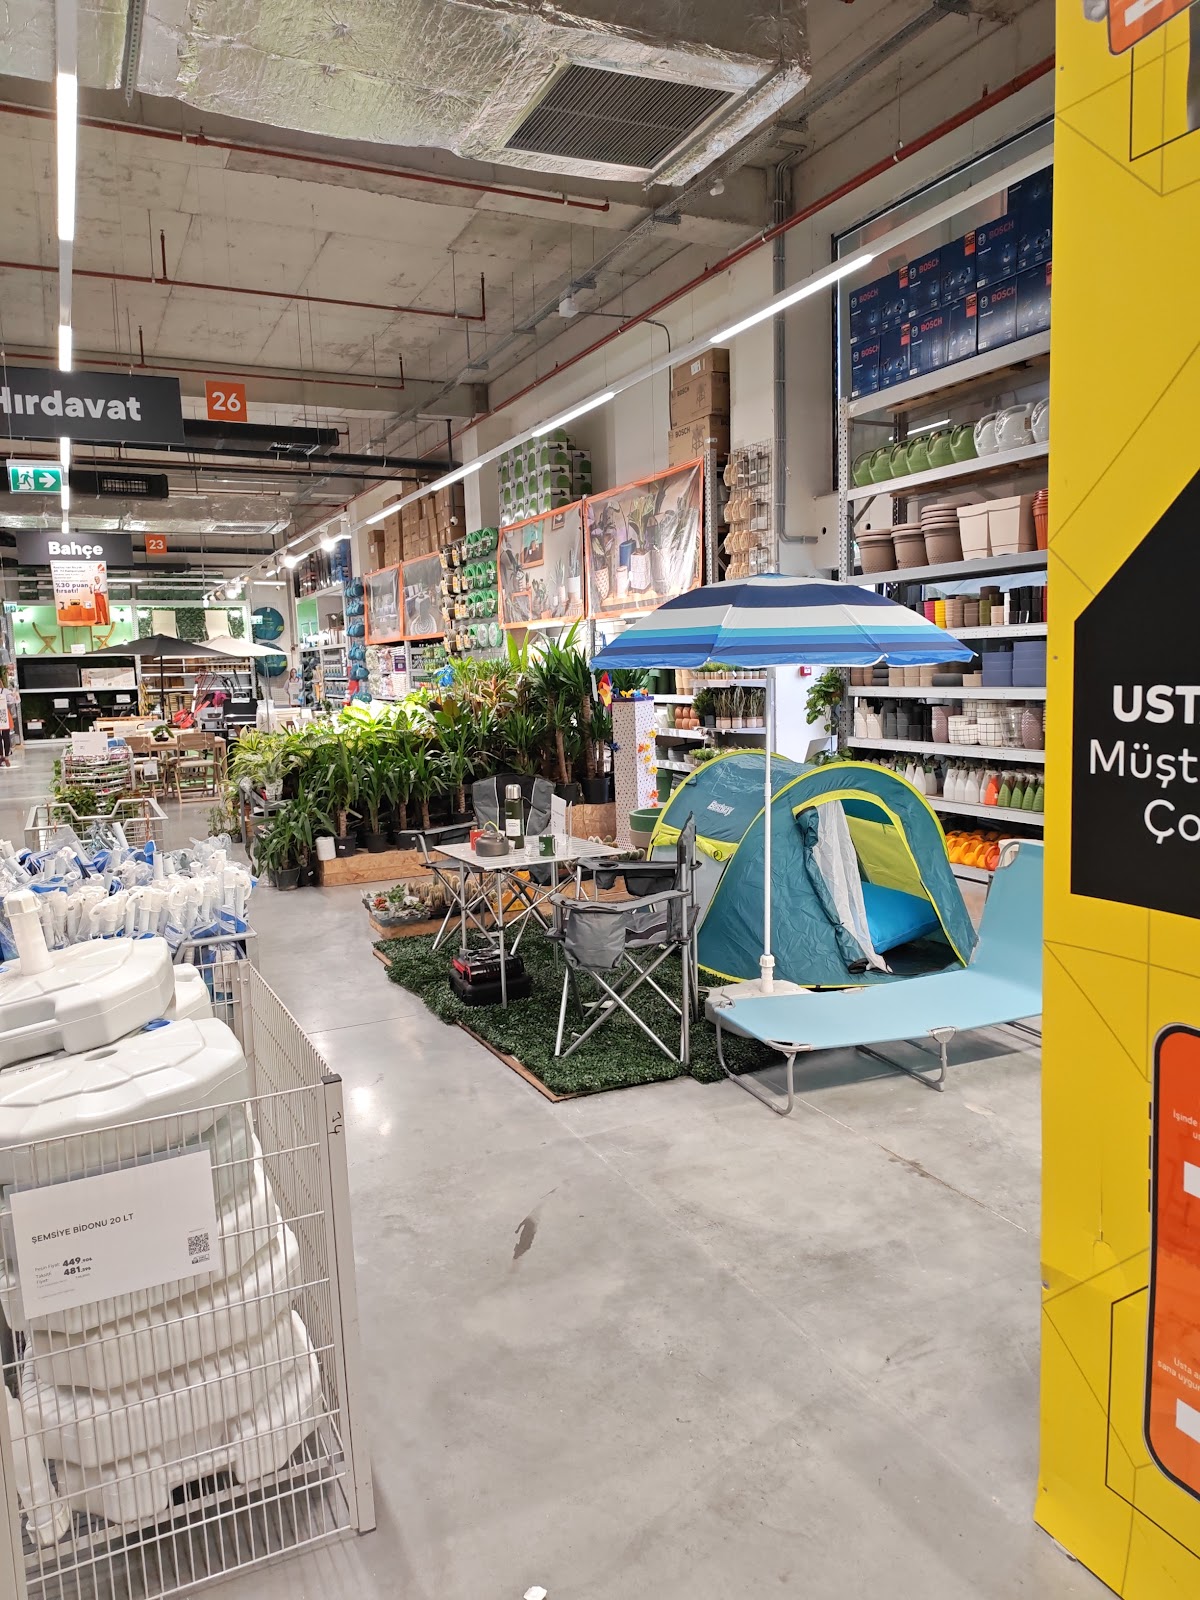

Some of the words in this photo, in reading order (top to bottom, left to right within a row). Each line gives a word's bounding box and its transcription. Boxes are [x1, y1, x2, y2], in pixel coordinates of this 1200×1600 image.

[989, 220, 1014, 240] BOSCH
[859, 288, 879, 303] BOSCH
[991, 285, 1016, 303] BOSCH
[920, 317, 943, 333] BOSCH
[0, 386, 142, 421] Hırdavat
[211, 391, 242, 412] 26
[675, 426, 691, 438] BOSCH
[48, 541, 104, 559] Bahçe
[149, 540, 164, 550] 23
[1112, 684, 1200, 724] UST
[1090, 738, 1199, 789] Müşt
[1144, 799, 1200, 844] Ço
[31, 1227, 71, 1244] ŞEMSİYE
[73, 1218, 108, 1234] BİDONU
[110, 1216, 121, 1225] 20
[123, 1212, 134, 1222] LT
[1157, 1360, 1177, 1377] sana
